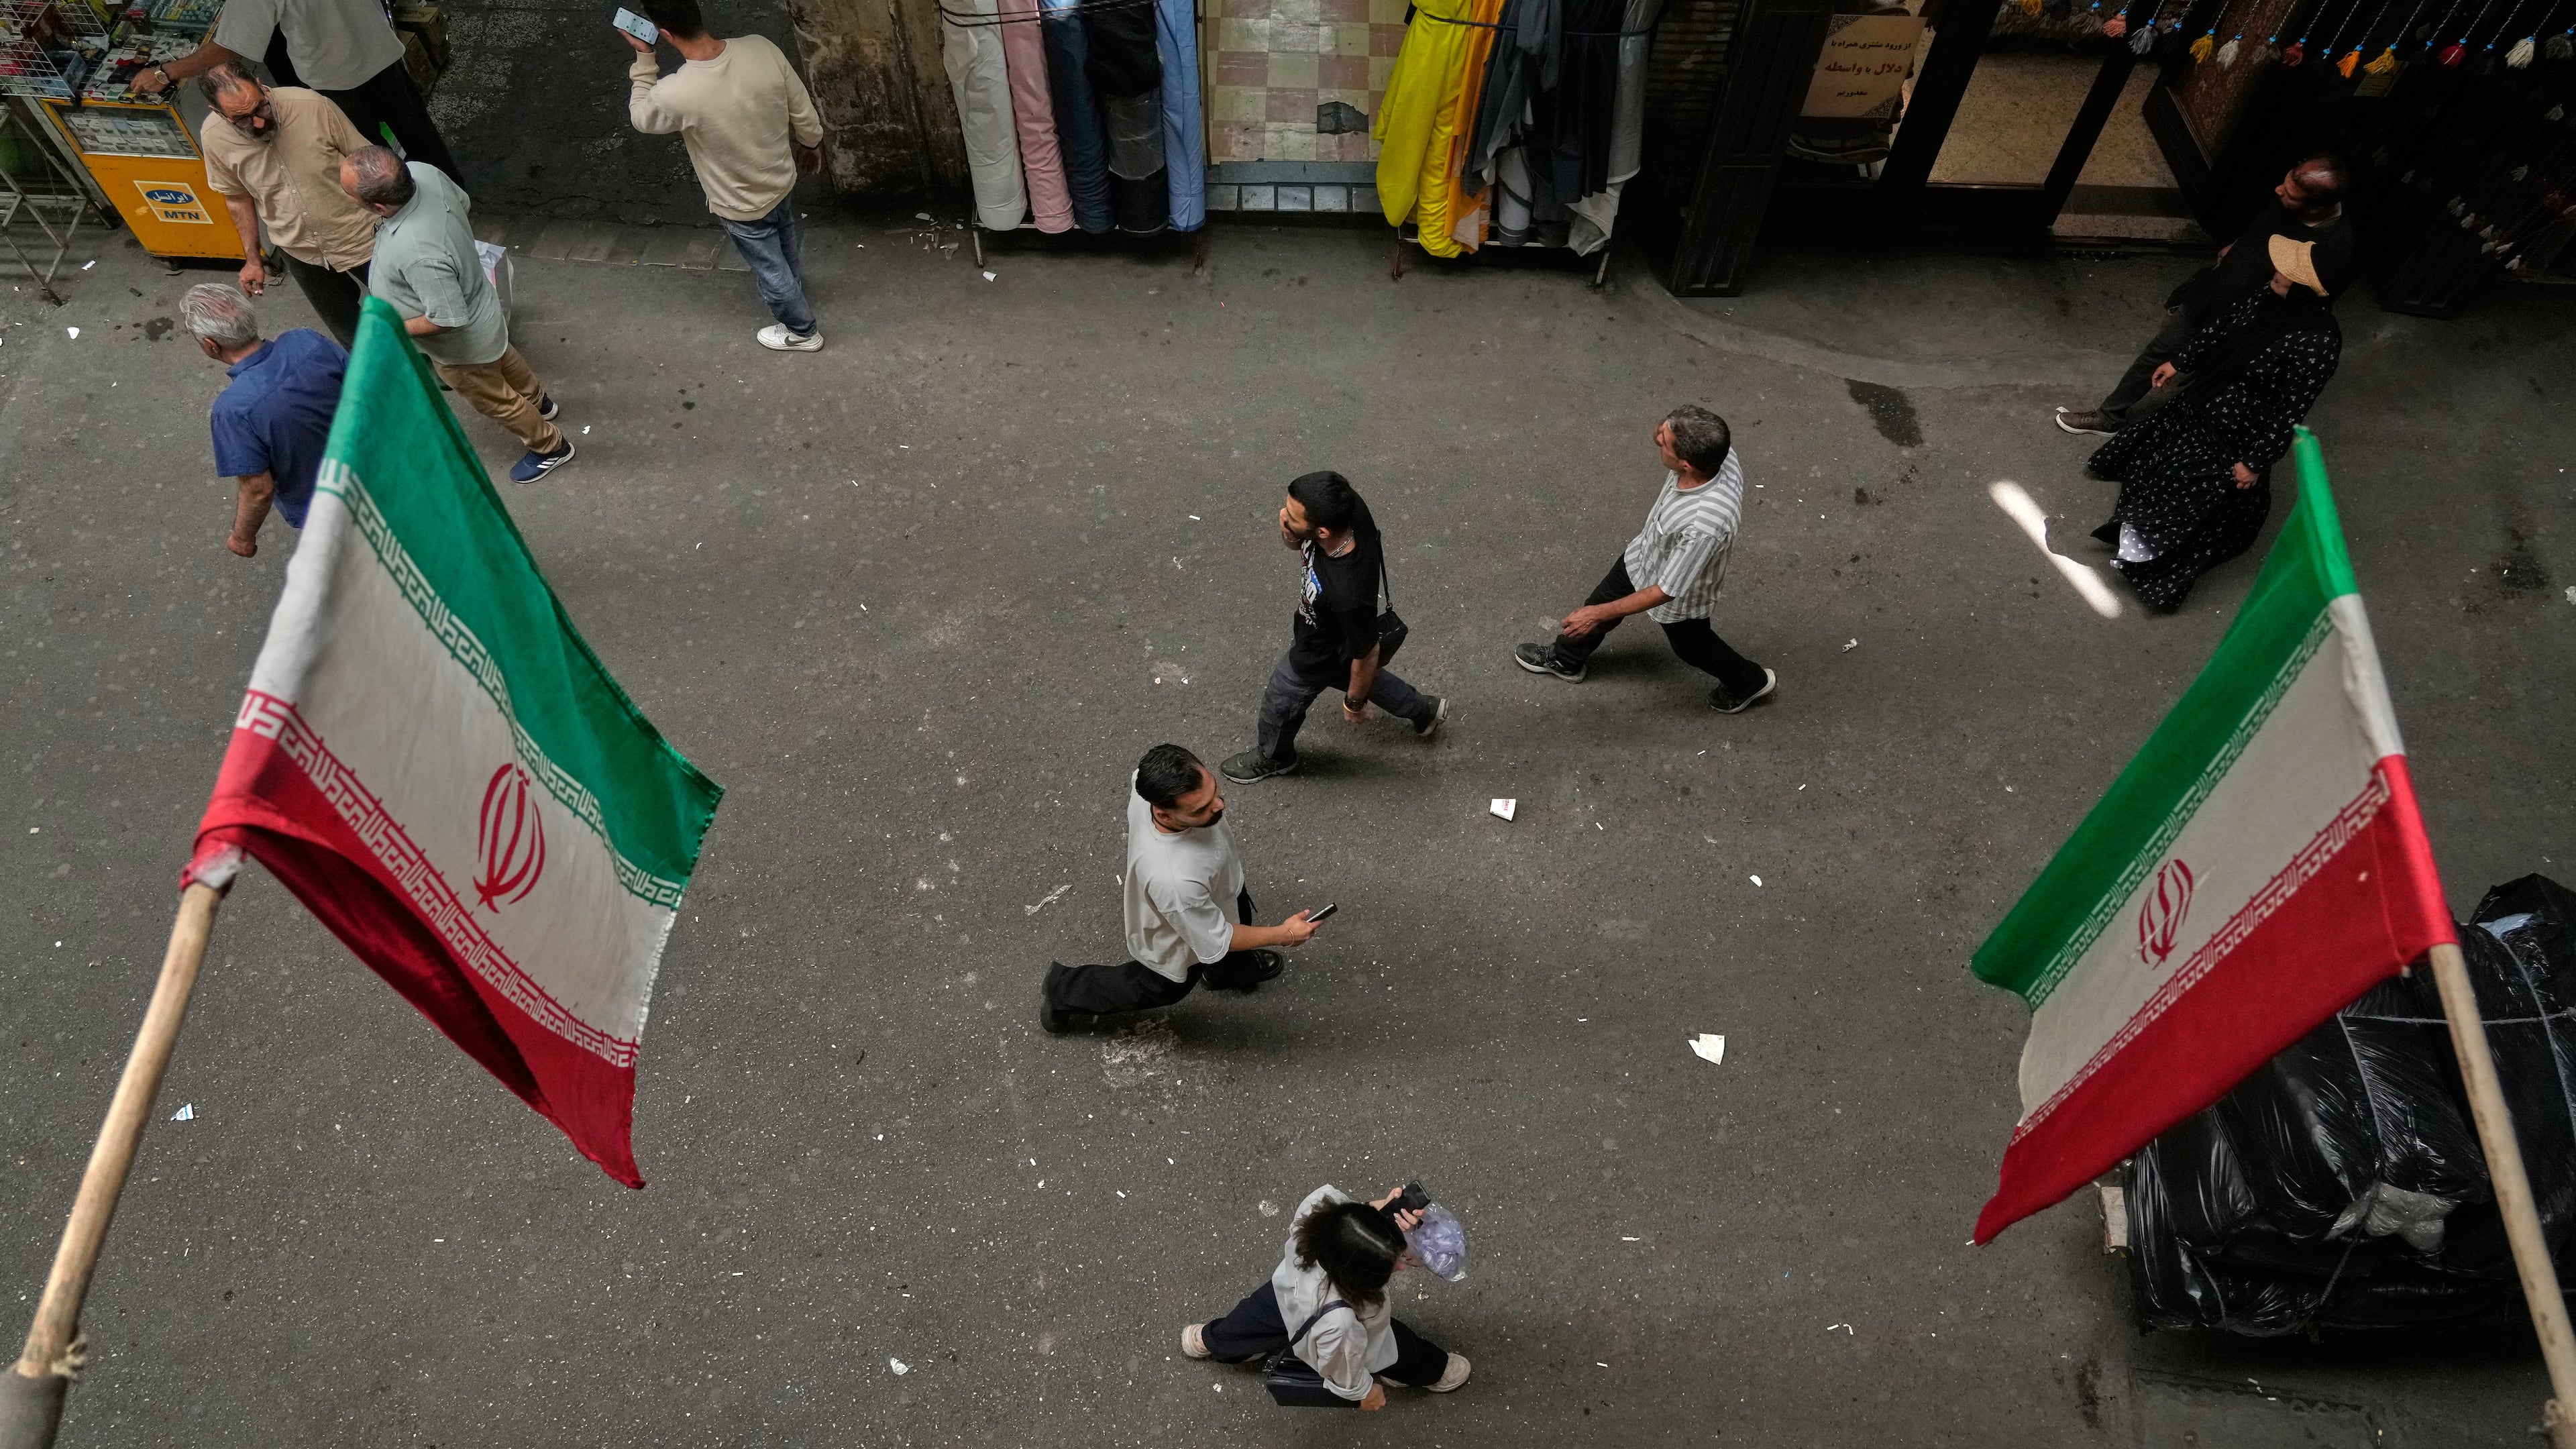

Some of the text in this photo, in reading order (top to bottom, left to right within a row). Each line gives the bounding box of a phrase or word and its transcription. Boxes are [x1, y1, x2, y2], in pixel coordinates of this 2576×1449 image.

[1837, 40, 1858, 49] همراه
[1903, 42, 1912, 50] از
[1824, 60, 1863, 76] واسطه
[1874, 62, 1902, 76] دلال
[164, 211, 200, 219] MTN
